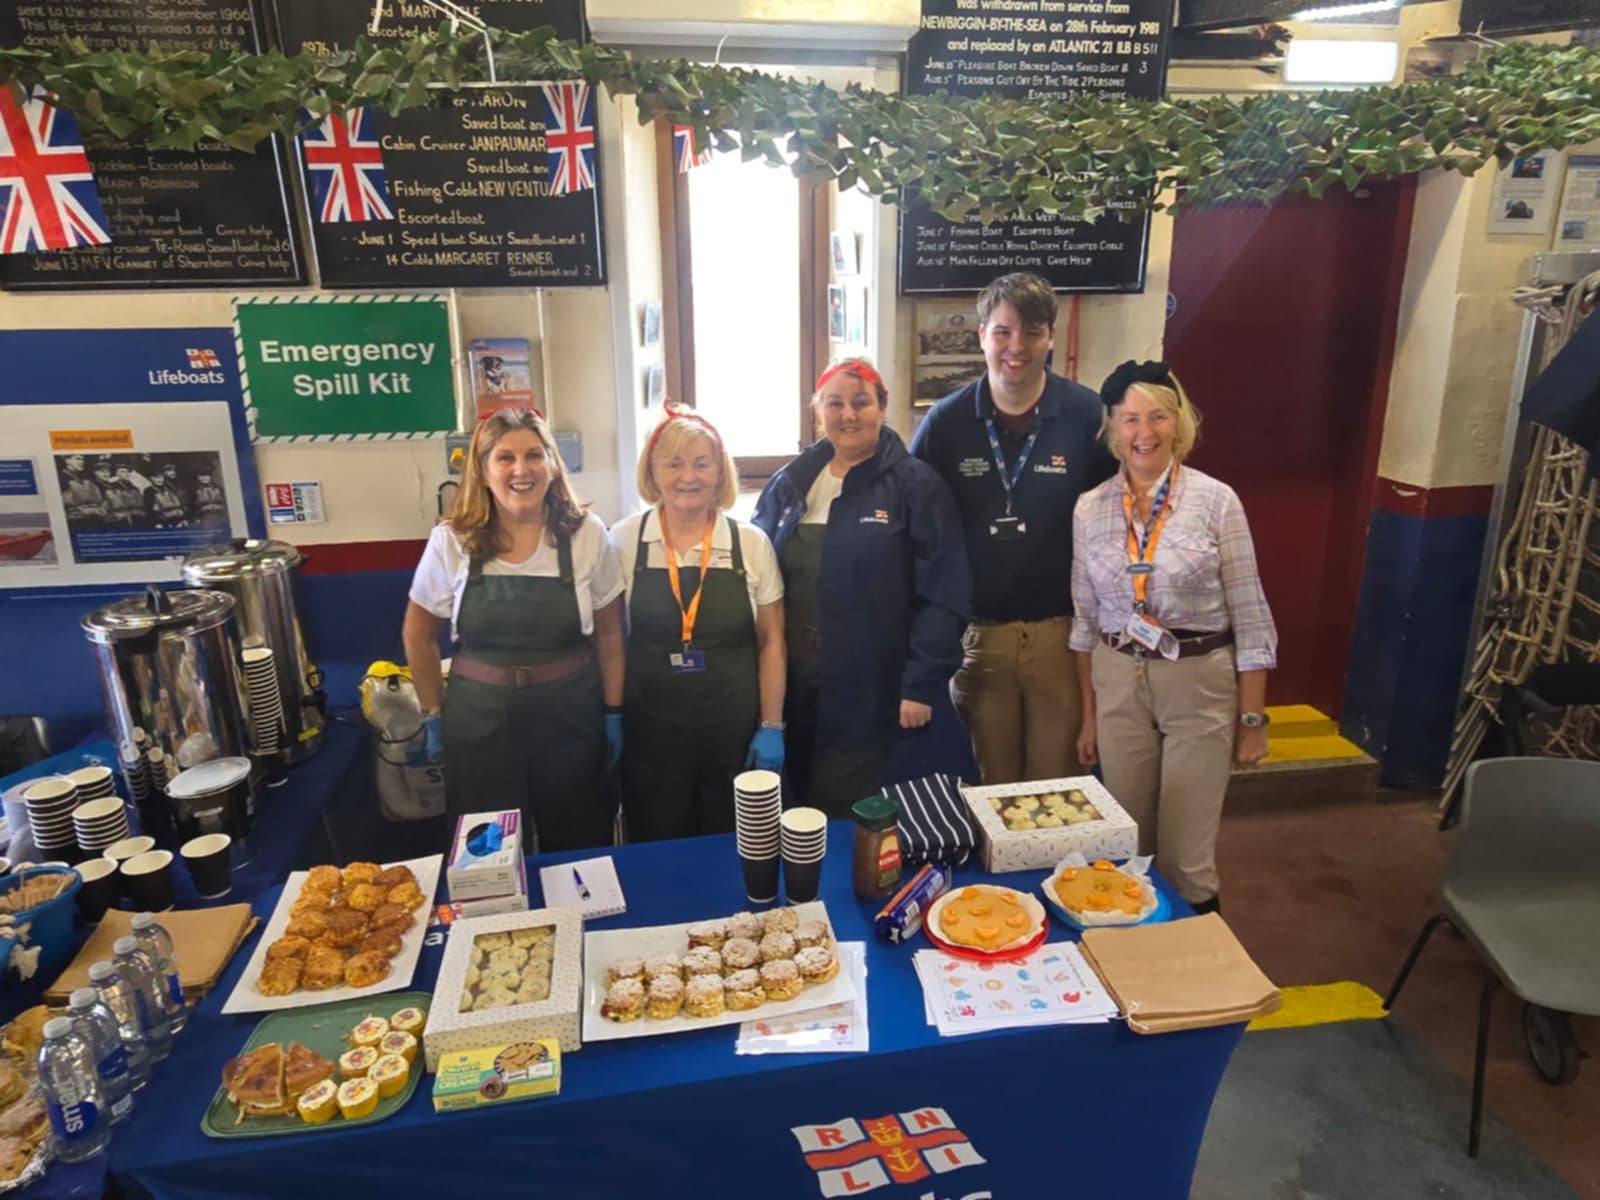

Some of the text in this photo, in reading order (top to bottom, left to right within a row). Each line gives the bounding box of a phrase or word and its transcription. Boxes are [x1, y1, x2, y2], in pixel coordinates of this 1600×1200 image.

[17, 6, 46, 17] sent
[48, 7, 64, 17] to
[65, 6, 87, 17] the
[89, 7, 131, 19] station
[146, 6, 217, 21] September
[219, 8, 250, 21] 1966
[400, 5, 437, 19] MARY
[981, 0, 1039, 12] withdrawn
[1067, 0, 1104, 14] service
[19, 18, 47, 31] This
[108, 22, 133, 33] was
[135, 24, 192, 37] provided
[195, 24, 218, 35] out
[220, 23, 232, 35] of
[237, 26, 246, 36] a
[1050, 22, 1063, 33] on
[1066, 20, 1088, 34] 28th
[1090, 20, 1136, 38] February
[1139, 21, 1159, 35] 1981
[117, 36, 140, 49] the
[201, 38, 215, 50] of
[219, 37, 241, 50] the
[947, 37, 968, 51] and
[970, 38, 1014, 54] replaced
[1017, 39, 1029, 56] by
[1032, 42, 1046, 53] an
[1048, 39, 1099, 54] ATLANTIC
[1102, 41, 1112, 54] 21
[1139, 61, 1148, 74] 3
[462, 113, 498, 130] Saved
[500, 114, 526, 130] boat
[381, 135, 546, 152] Cabin Cruiser JANPAUMAR
[148, 156, 199, 171] Escorted
[200, 157, 235, 171] boats
[466, 157, 503, 174] Saved
[504, 158, 531, 174] boat
[394, 180, 441, 204] Fishing
[443, 180, 478, 197] Coble
[479, 180, 505, 198] NEW
[158, 208, 181, 223] and
[398, 208, 486, 226] Escorted boat
[249, 224, 273, 240] help
[401, 230, 438, 249] Speed
[440, 231, 467, 246] boat
[281, 240, 291, 252] 6
[162, 254, 172, 269] of
[401, 252, 434, 267] Coble
[435, 251, 500, 267] MARGARET
[506, 251, 554, 267] RENNER
[584, 264, 592, 277] 2
[259, 340, 436, 367] Emergency
[148, 369, 225, 385] Lifeboats
[293, 372, 412, 401] Spill Kit
[815, 1109, 941, 1147] R N
[841, 1147, 961, 1191] L I
